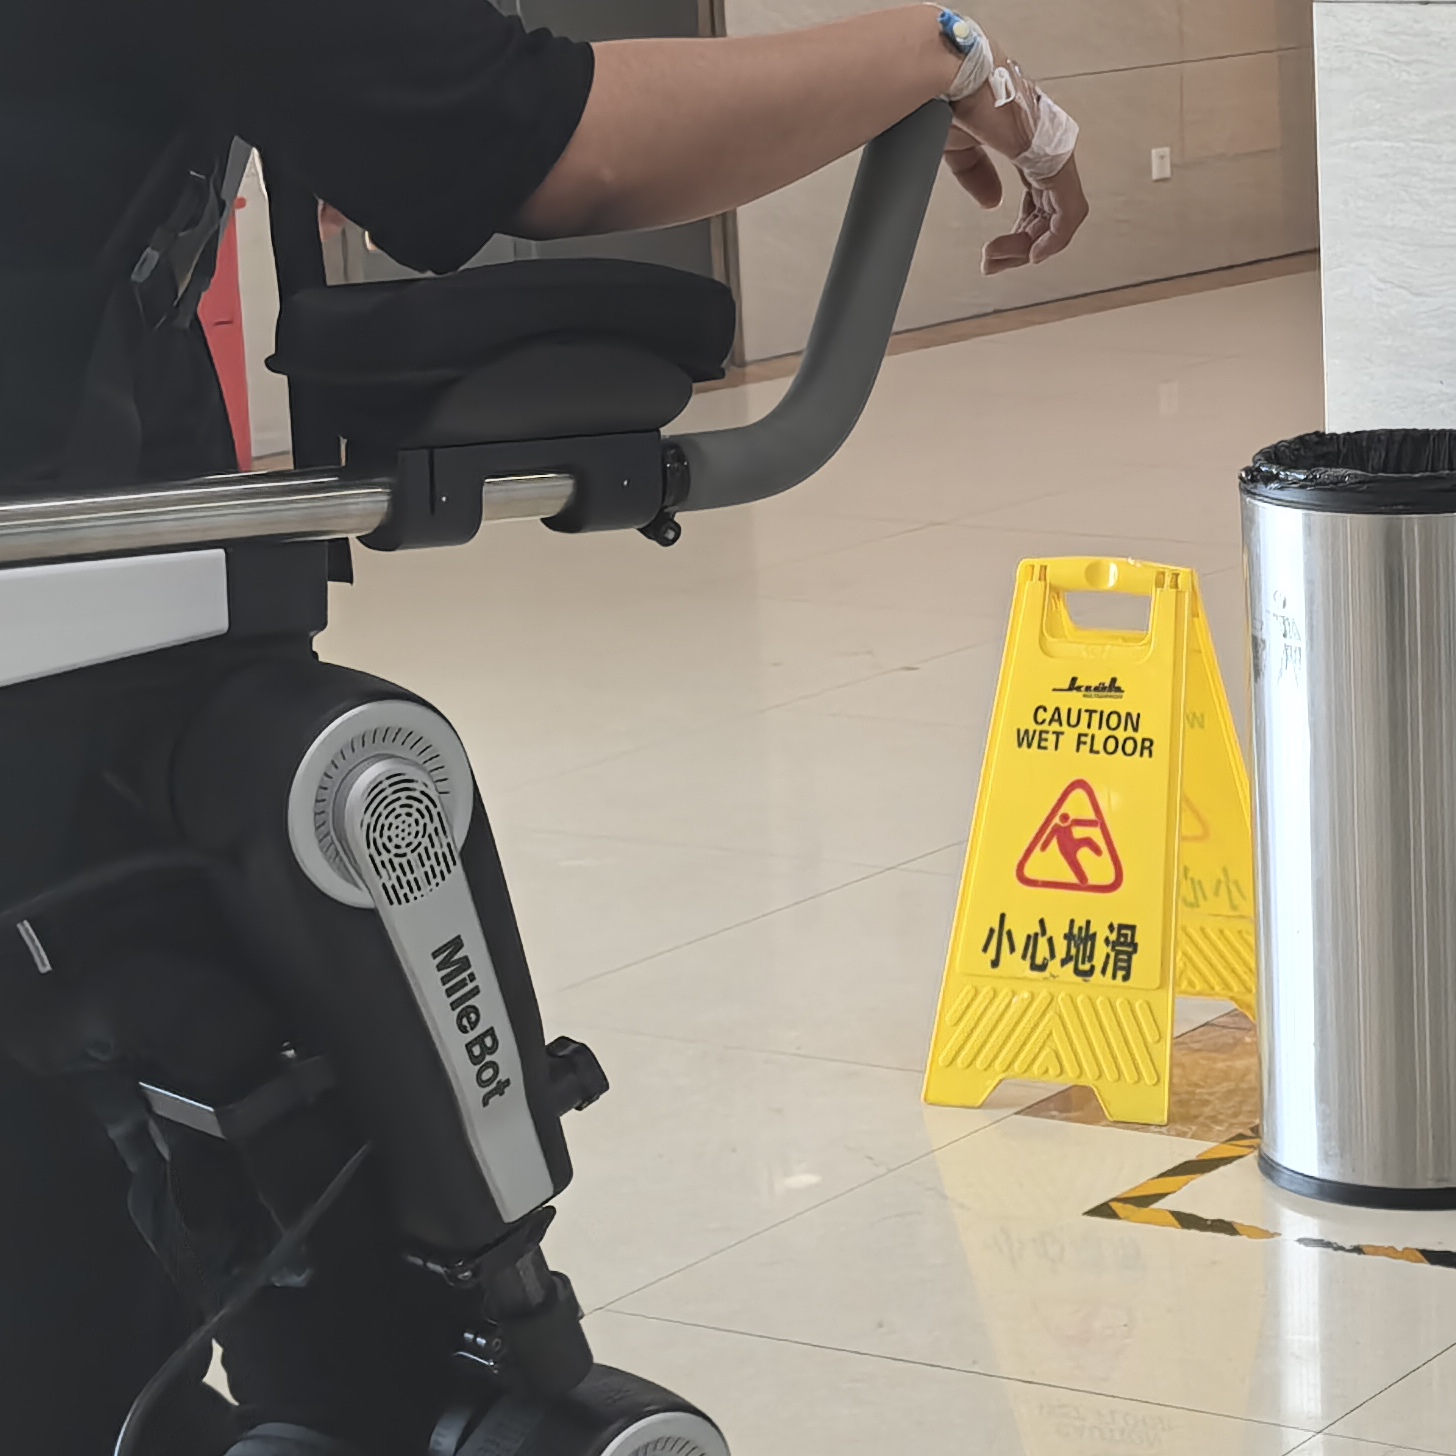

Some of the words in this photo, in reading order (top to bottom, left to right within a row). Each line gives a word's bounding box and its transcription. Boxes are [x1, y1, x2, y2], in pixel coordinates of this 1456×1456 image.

[1033, 705, 1141, 733] CAUTION
[1016, 728, 1064, 751] WET
[1075, 733, 1154, 758] FLOOR
[981, 912, 1139, 983] 小心地滑
